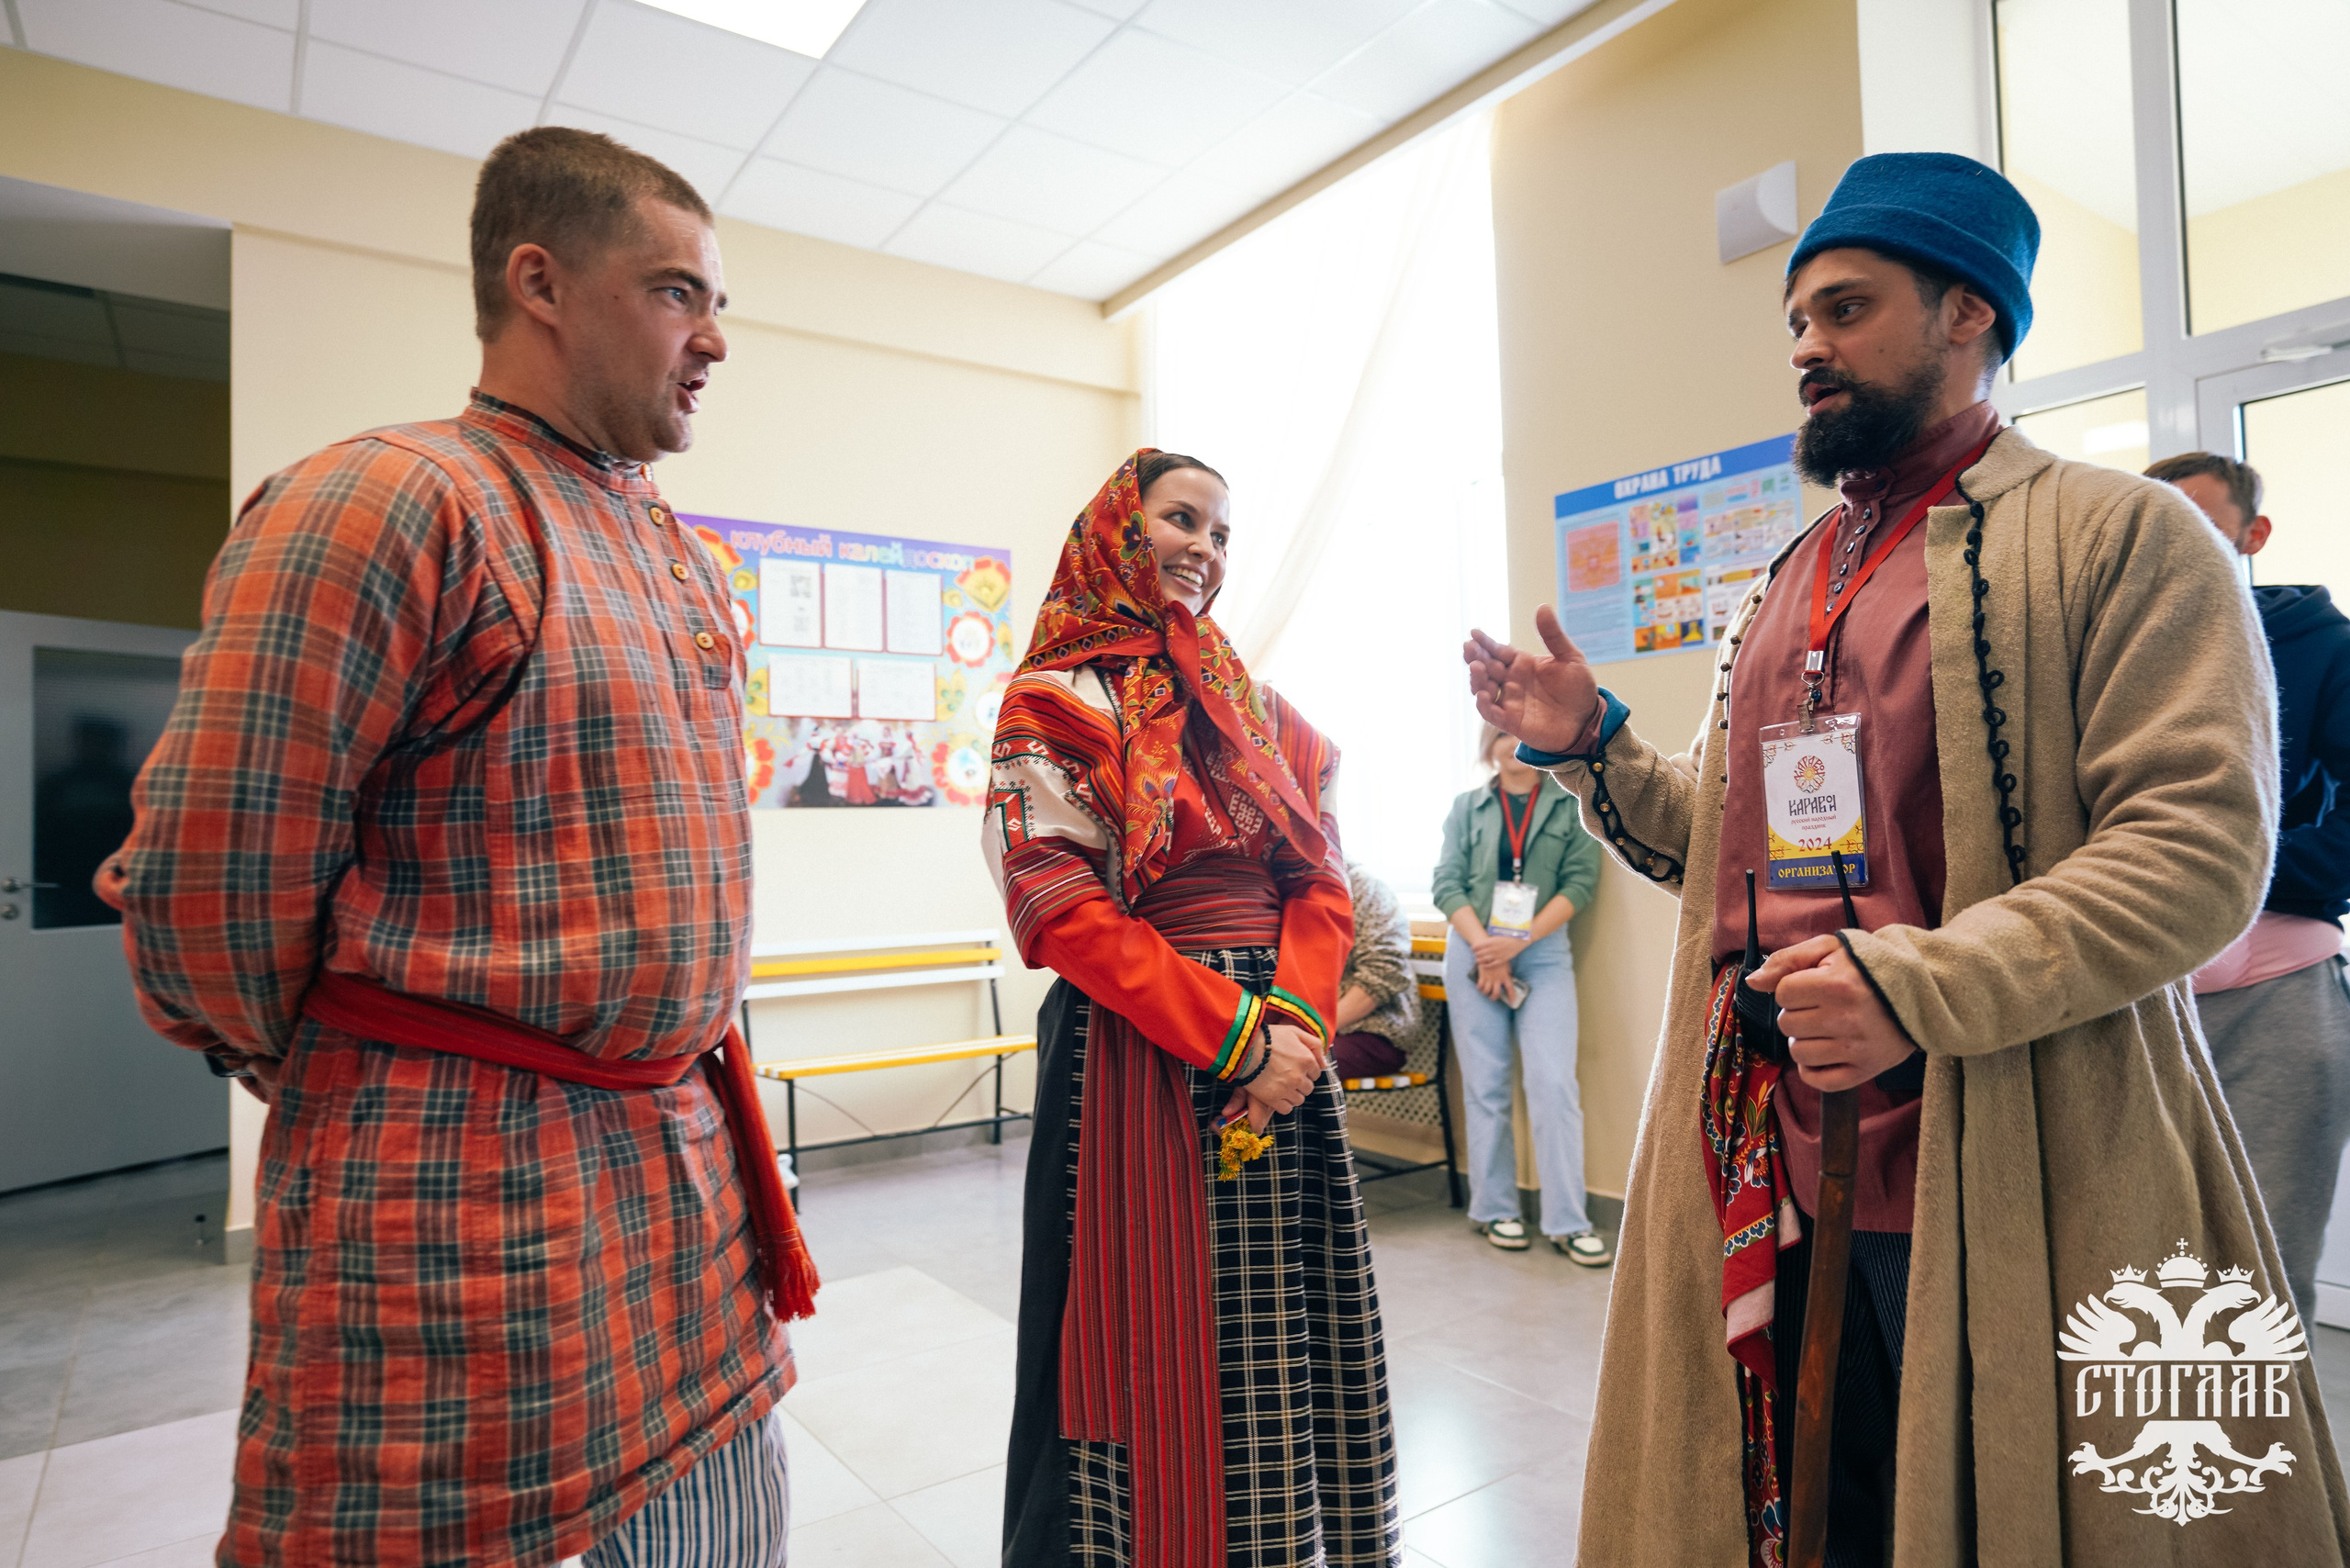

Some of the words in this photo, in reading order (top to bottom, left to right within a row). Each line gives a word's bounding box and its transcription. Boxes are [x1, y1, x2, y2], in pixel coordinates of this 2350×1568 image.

[1614, 469, 1669, 499] ОХРАНА
[1673, 455, 1721, 485] ТРУДА
[730, 530, 833, 557] клубный
[1791, 817, 1811, 825] русский
[1811, 814, 1837, 823] народный
[1798, 836, 1832, 852] 2024
[1778, 863, 1856, 879] ОРГАНИЗАОР
